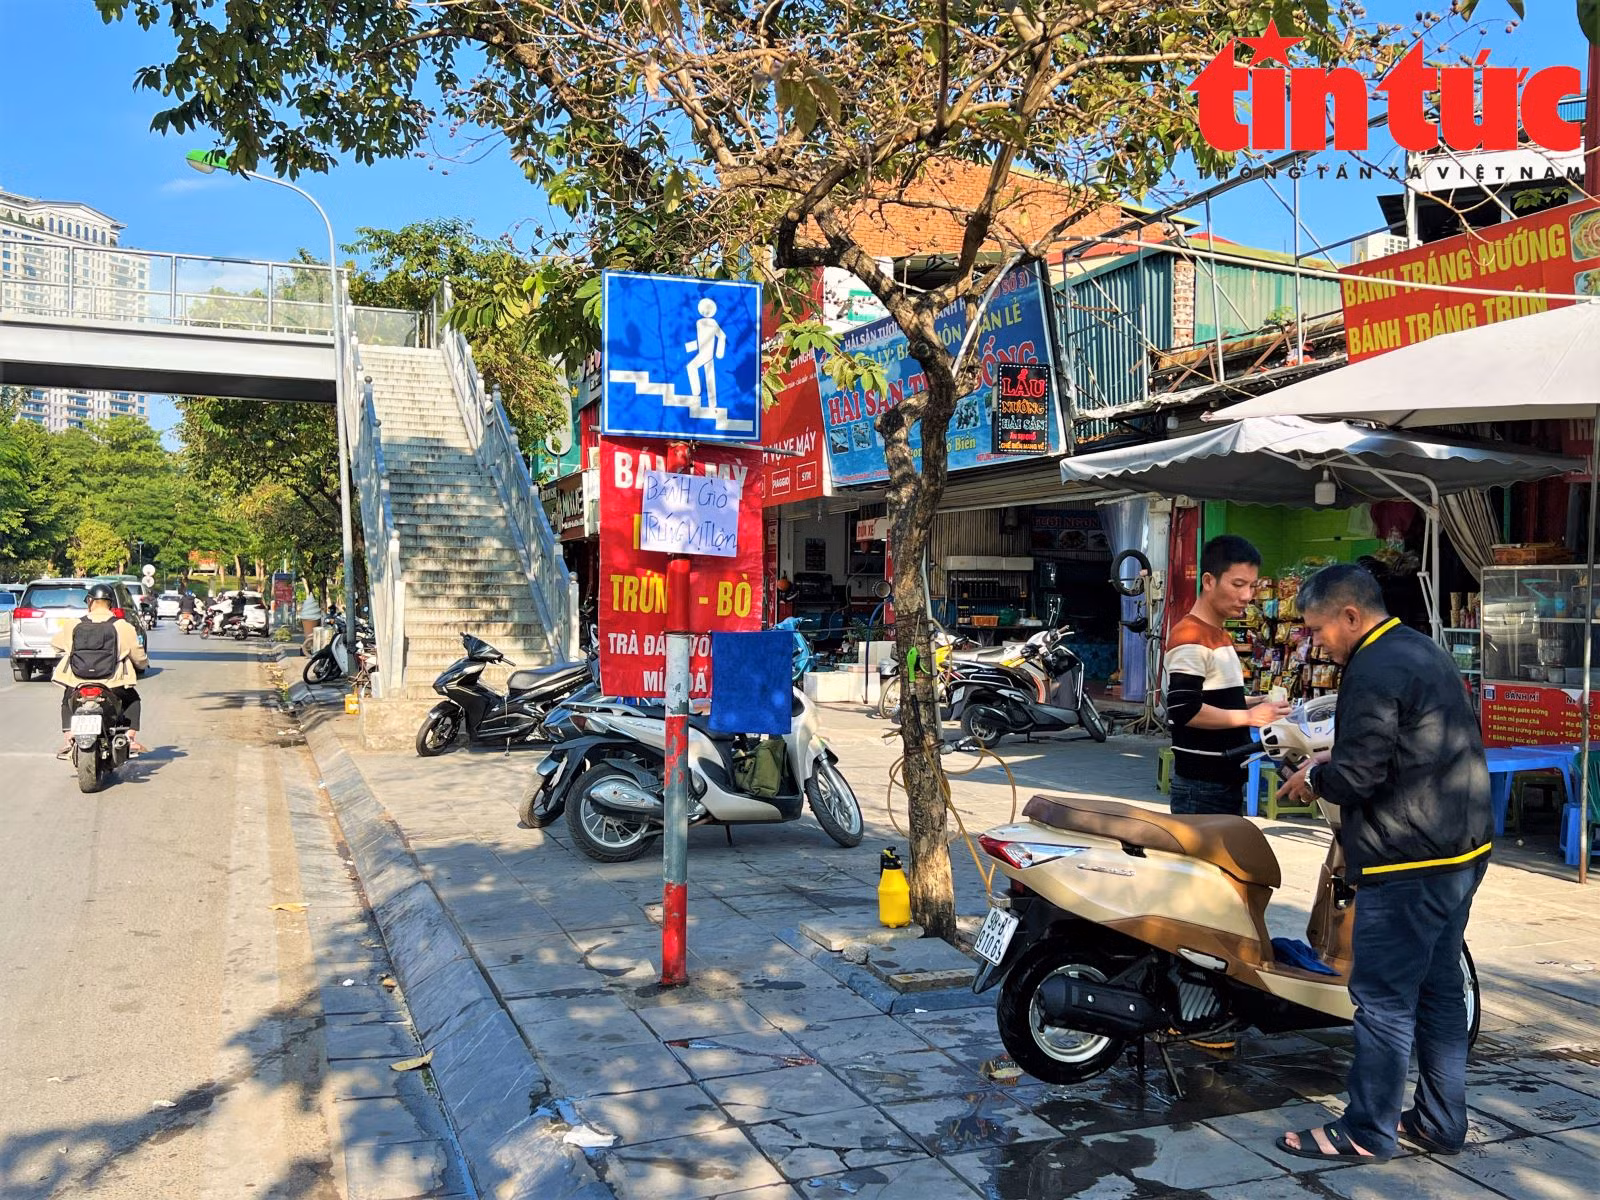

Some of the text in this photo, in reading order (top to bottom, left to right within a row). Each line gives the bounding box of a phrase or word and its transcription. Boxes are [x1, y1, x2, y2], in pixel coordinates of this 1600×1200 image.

[1400, 249, 1473, 293] TRÁNG
[1478, 223, 1566, 276] NƯỚNG
[1349, 318, 1402, 356] BÁNH
[1405, 302, 1477, 345] TRÁNG
[1002, 368, 1045, 398] LẨU
[796, 426, 817, 458] MÁY
[610, 569, 668, 614] TRỨN
[716, 573, 752, 618] BÒ
[607, 630, 713, 658] TRÀ ĐÁ VỐ
[643, 667, 667, 692] MÍ
[1504, 689, 1527, 700] BÁNH
